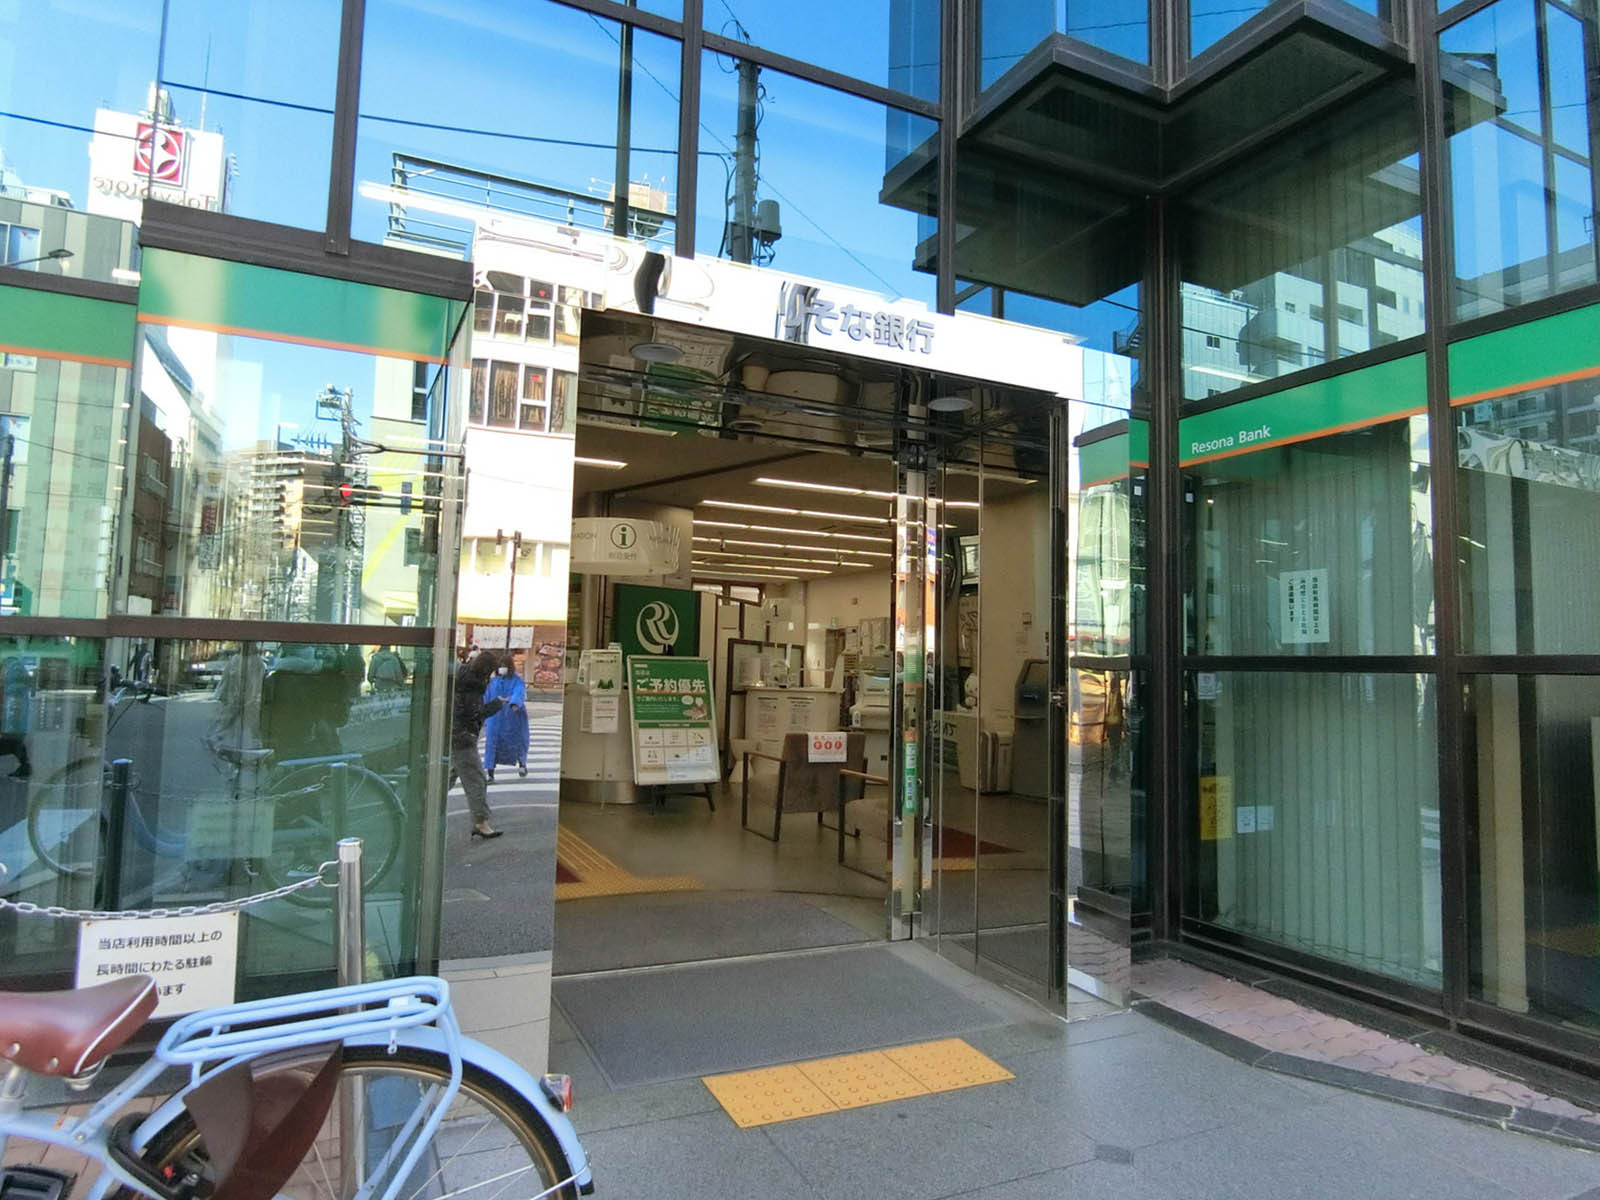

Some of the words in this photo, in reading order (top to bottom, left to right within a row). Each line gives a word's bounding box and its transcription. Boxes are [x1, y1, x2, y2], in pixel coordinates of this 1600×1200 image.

[1191, 435, 1235, 455] Resona
[1238, 424, 1272, 444] Bank
[636, 678, 706, 694] ご予約優先
[98, 930, 222, 950] 当店利用時間以上の
[96, 955, 213, 976] 長時間にわたる駐輪
